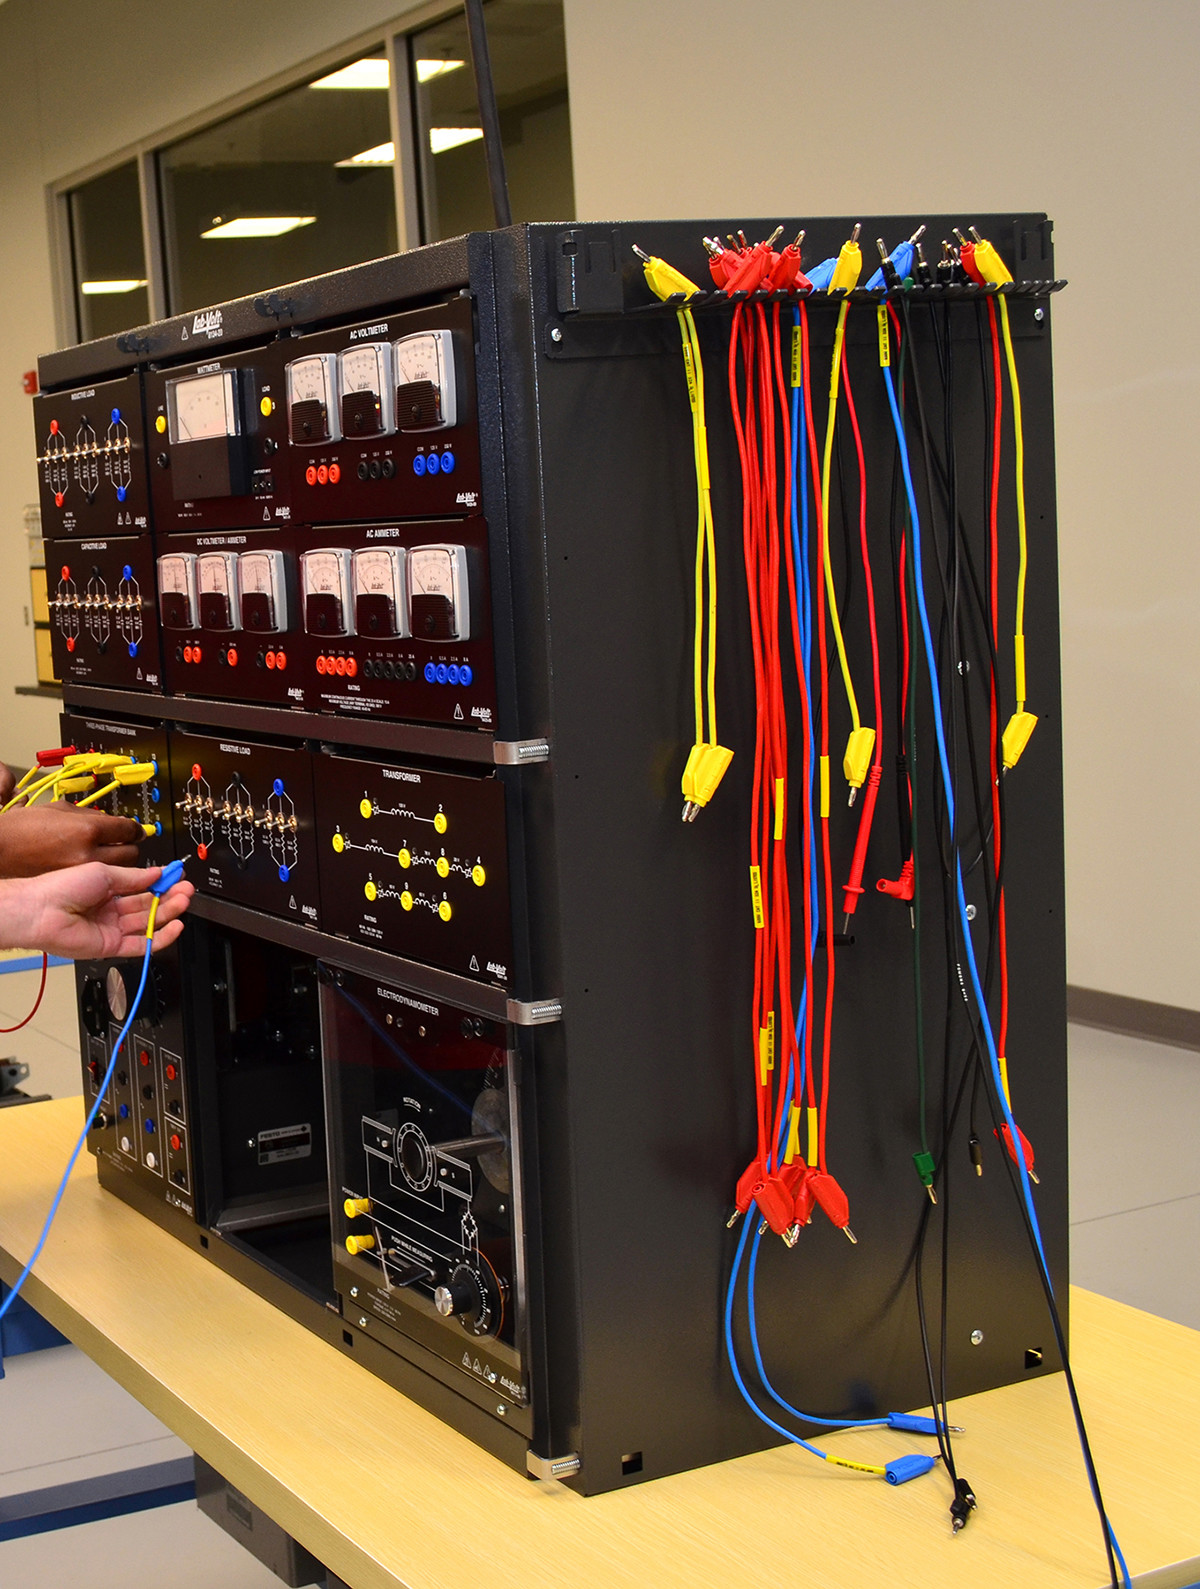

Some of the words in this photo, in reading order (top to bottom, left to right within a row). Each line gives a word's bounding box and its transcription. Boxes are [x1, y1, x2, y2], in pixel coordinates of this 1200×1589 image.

[349, 330, 357, 340] AC
[358, 323, 389, 338] VOLTMETER
[197, 362, 220, 374] WATTMETER
[366, 529, 374, 538] AC
[374, 528, 400, 538] AMMETER
[382, 769, 421, 783] TRANSFORMER
[438, 804, 443, 812] 2
[336, 825, 340, 833] 3
[402, 839, 407, 847] 7
[441, 848, 445, 856] 8
[476, 856, 481, 864] 4
[368, 872, 373, 880] 5
[404, 882, 409, 890] 9
[442, 892, 447, 900] 6
[376, 987, 439, 1016] ELECTRODYNAMOMETER
